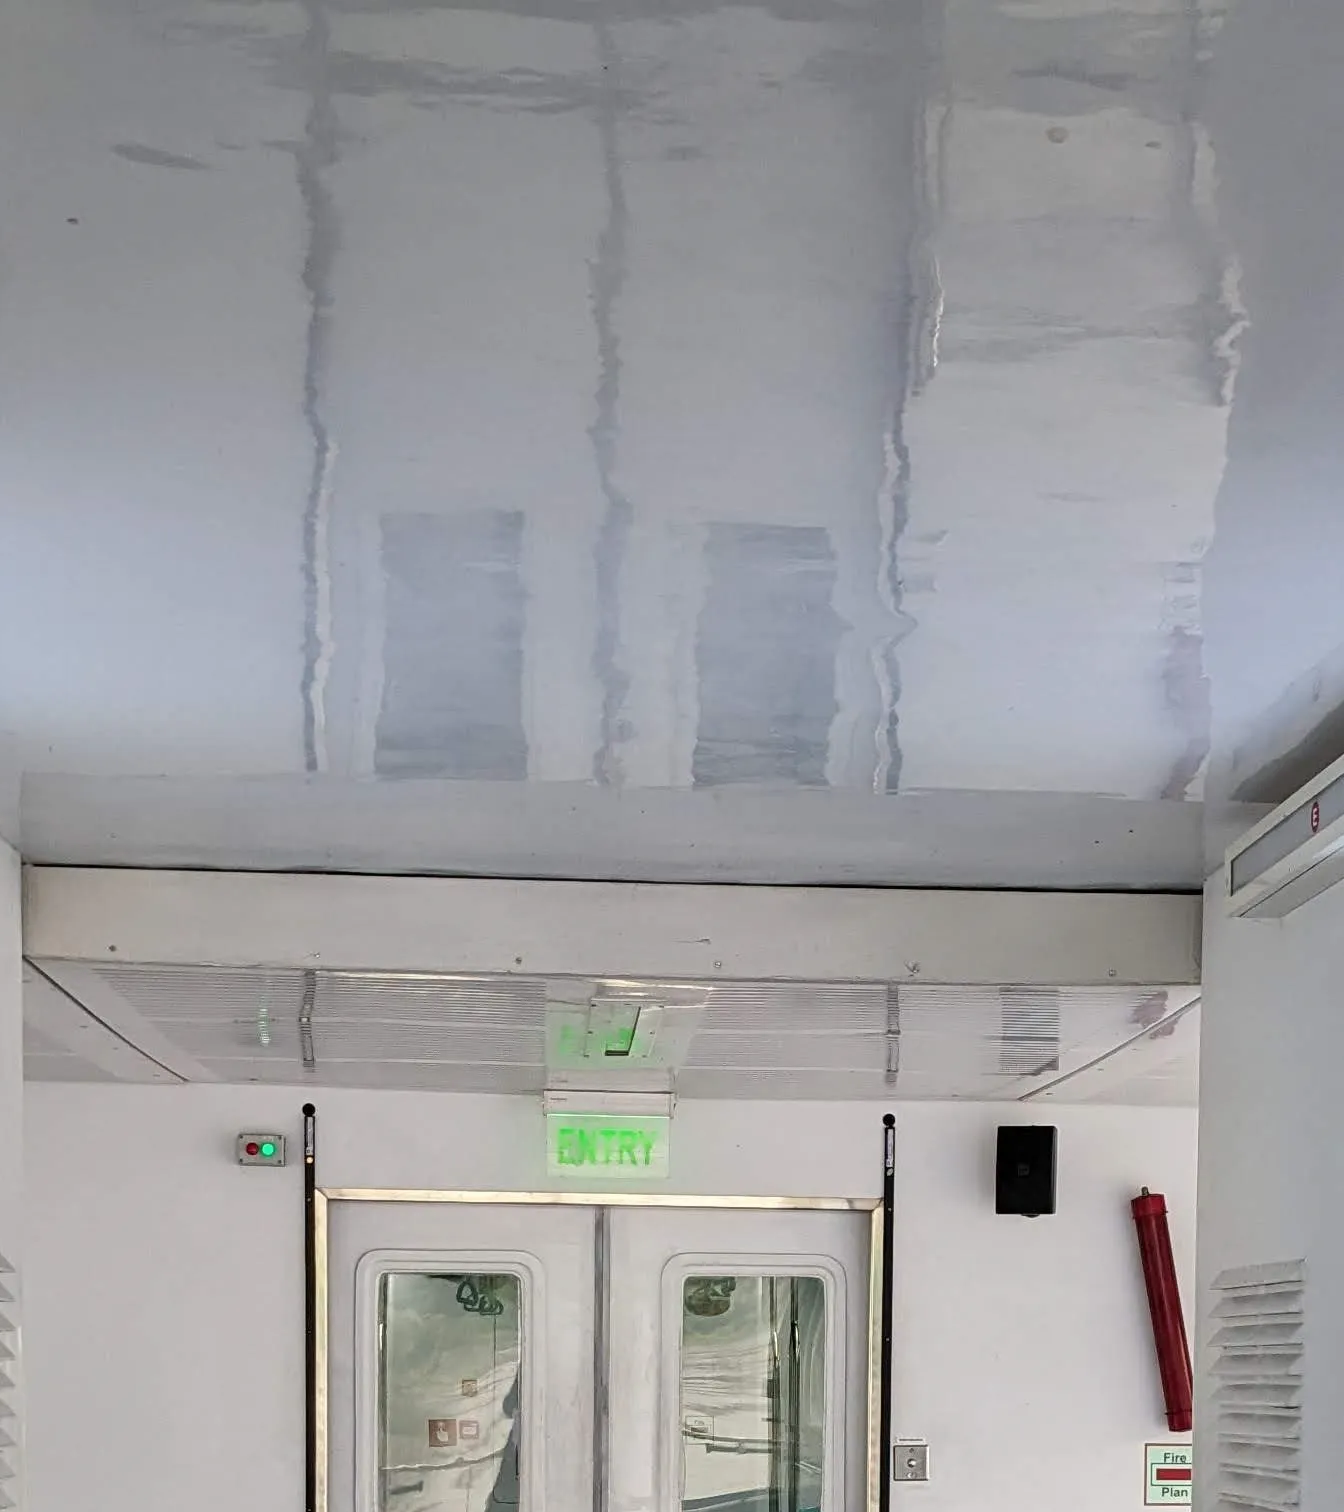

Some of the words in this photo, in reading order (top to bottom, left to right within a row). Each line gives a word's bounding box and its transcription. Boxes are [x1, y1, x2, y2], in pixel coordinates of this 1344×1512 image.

[558, 1128, 658, 1166] ENTRY
[1163, 1452, 1187, 1464] Fire
[1161, 1487, 1189, 1498] Plan
